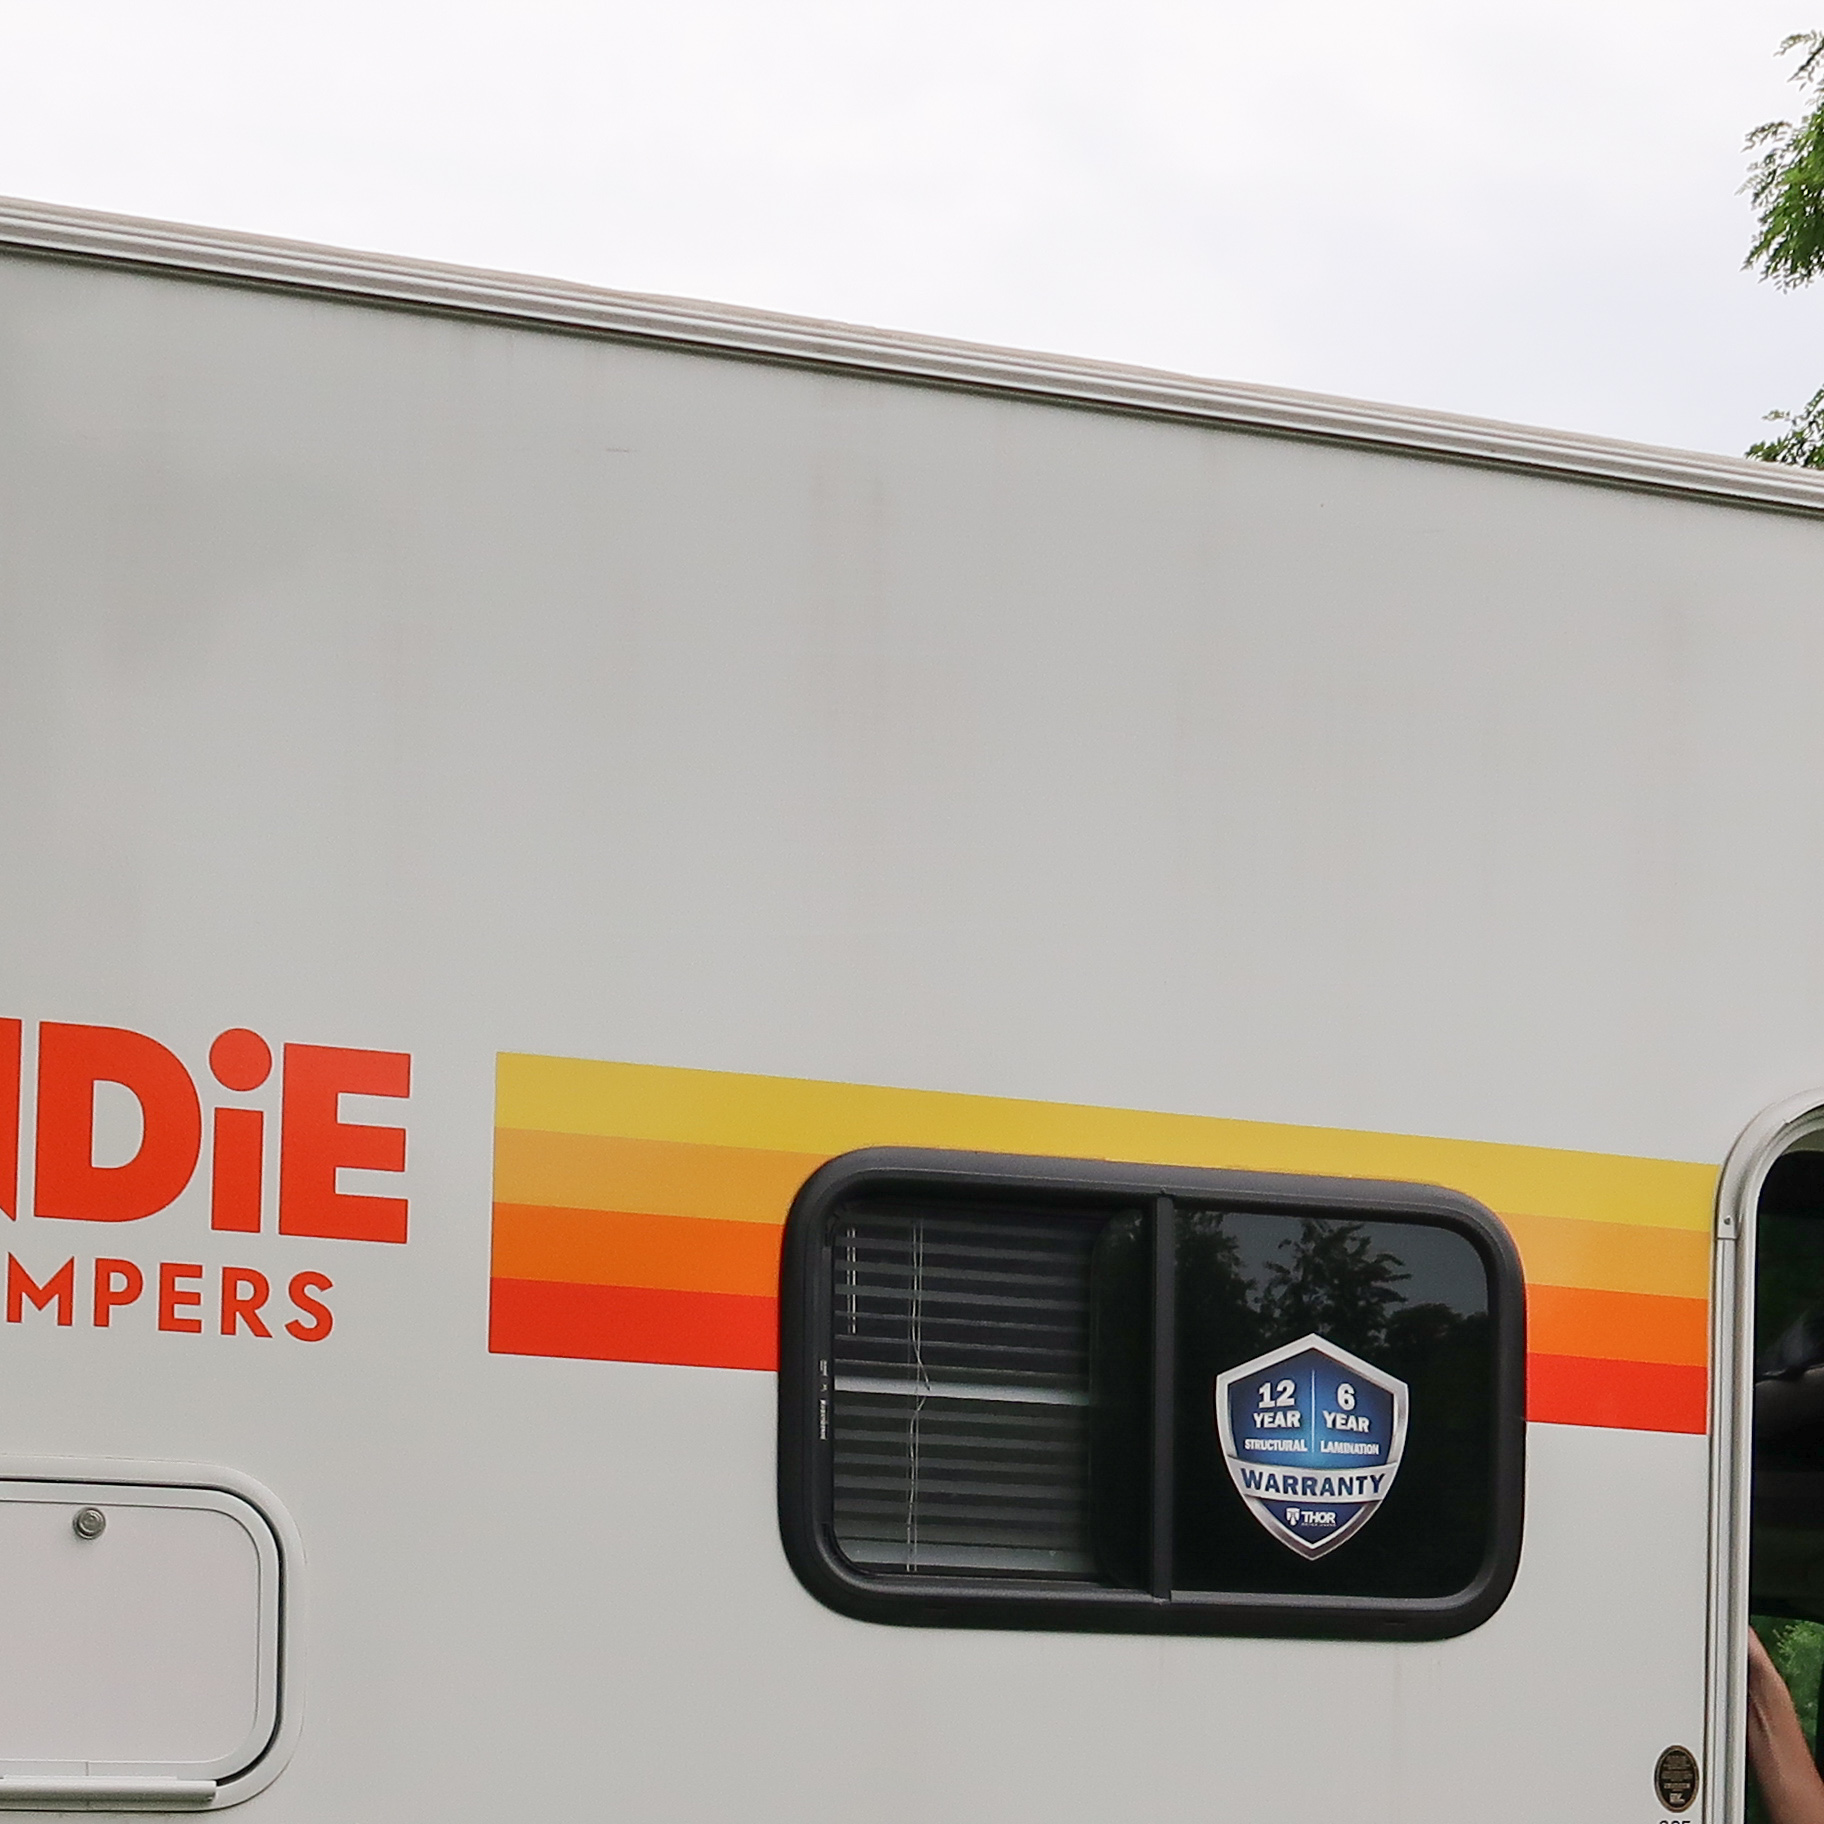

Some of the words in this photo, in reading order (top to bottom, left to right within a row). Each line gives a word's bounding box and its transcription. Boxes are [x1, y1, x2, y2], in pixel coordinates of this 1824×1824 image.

[1258, 1379, 1296, 1409] 12
[1337, 1382, 1356, 1411] 6
[1252, 1410, 1303, 1428] YEAR
[1322, 1410, 1371, 1432] YEAR
[1244, 1438, 1308, 1452] STRUCTURAL
[1320, 1440, 1380, 1456] LAMINATION
[1240, 1468, 1387, 1497] WARRANTY
[1301, 1510, 1337, 1524] THOR
